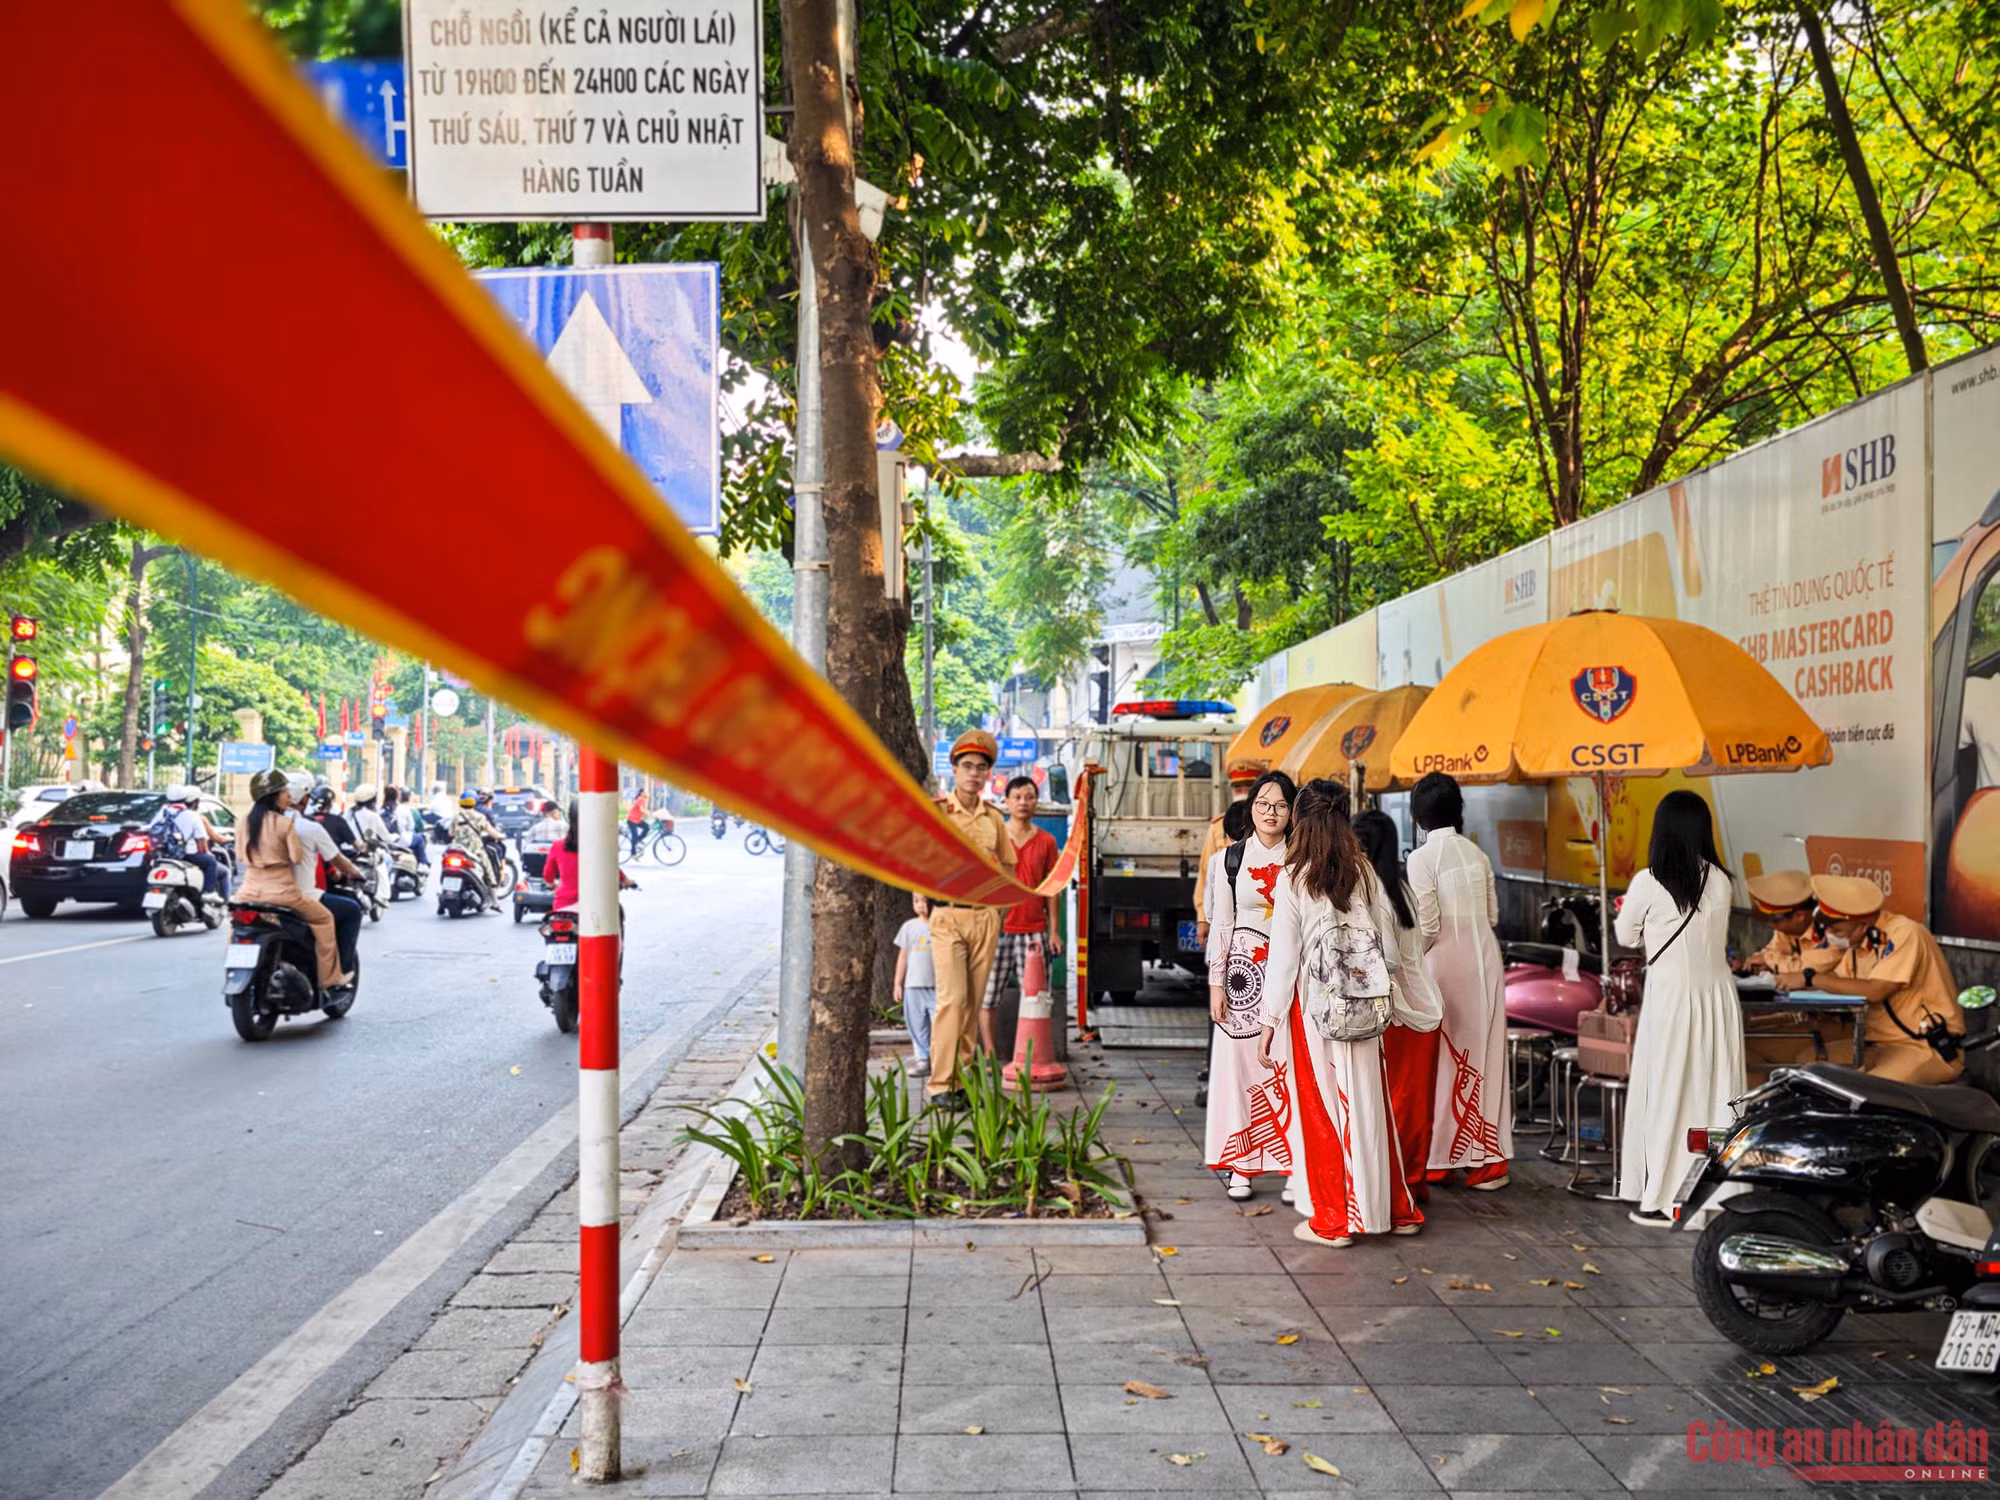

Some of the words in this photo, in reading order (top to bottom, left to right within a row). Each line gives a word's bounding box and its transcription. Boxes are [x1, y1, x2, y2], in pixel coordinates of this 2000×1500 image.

[430, 9, 472, 46] CHỖ
[480, 9, 531, 45] NGỒI
[539, 6, 578, 46] (KỂ
[584, 8, 611, 44] CẢ
[618, 9, 685, 44] NGƯỜI
[694, 9, 736, 46] LÁI)
[418, 62, 446, 96] TỪ
[454, 68, 517, 96] 19H00
[523, 57, 566, 95] ĐẾN
[573, 67, 637, 94] 24H00
[644, 60, 685, 94] CÁC
[693, 60, 750, 94] NGÀY
[429, 111, 472, 145] THỨ
[534, 110, 577, 144] THỨ
[584, 118, 596, 144] 7
[602, 110, 630, 144] VÀ
[637, 109, 680, 144] CHỦ
[688, 113, 744, 150] NHẬT
[522, 159, 580, 193] HÀNG
[587, 157, 643, 193] TUẦN
[1845, 433, 1896, 491] SHB
[1833, 558, 1874, 600] QUỐC
[1877, 550, 1894, 590] TẾ
[1771, 609, 1893, 661] MASTERCARD
[1795, 655, 1893, 699] CASHBACK
[1414, 753, 1473, 774] LPBank
[1571, 743, 1644, 766] CSGT
[1726, 744, 1788, 763] LPBank
[1940, 1342, 1996, 1368] 216.66
